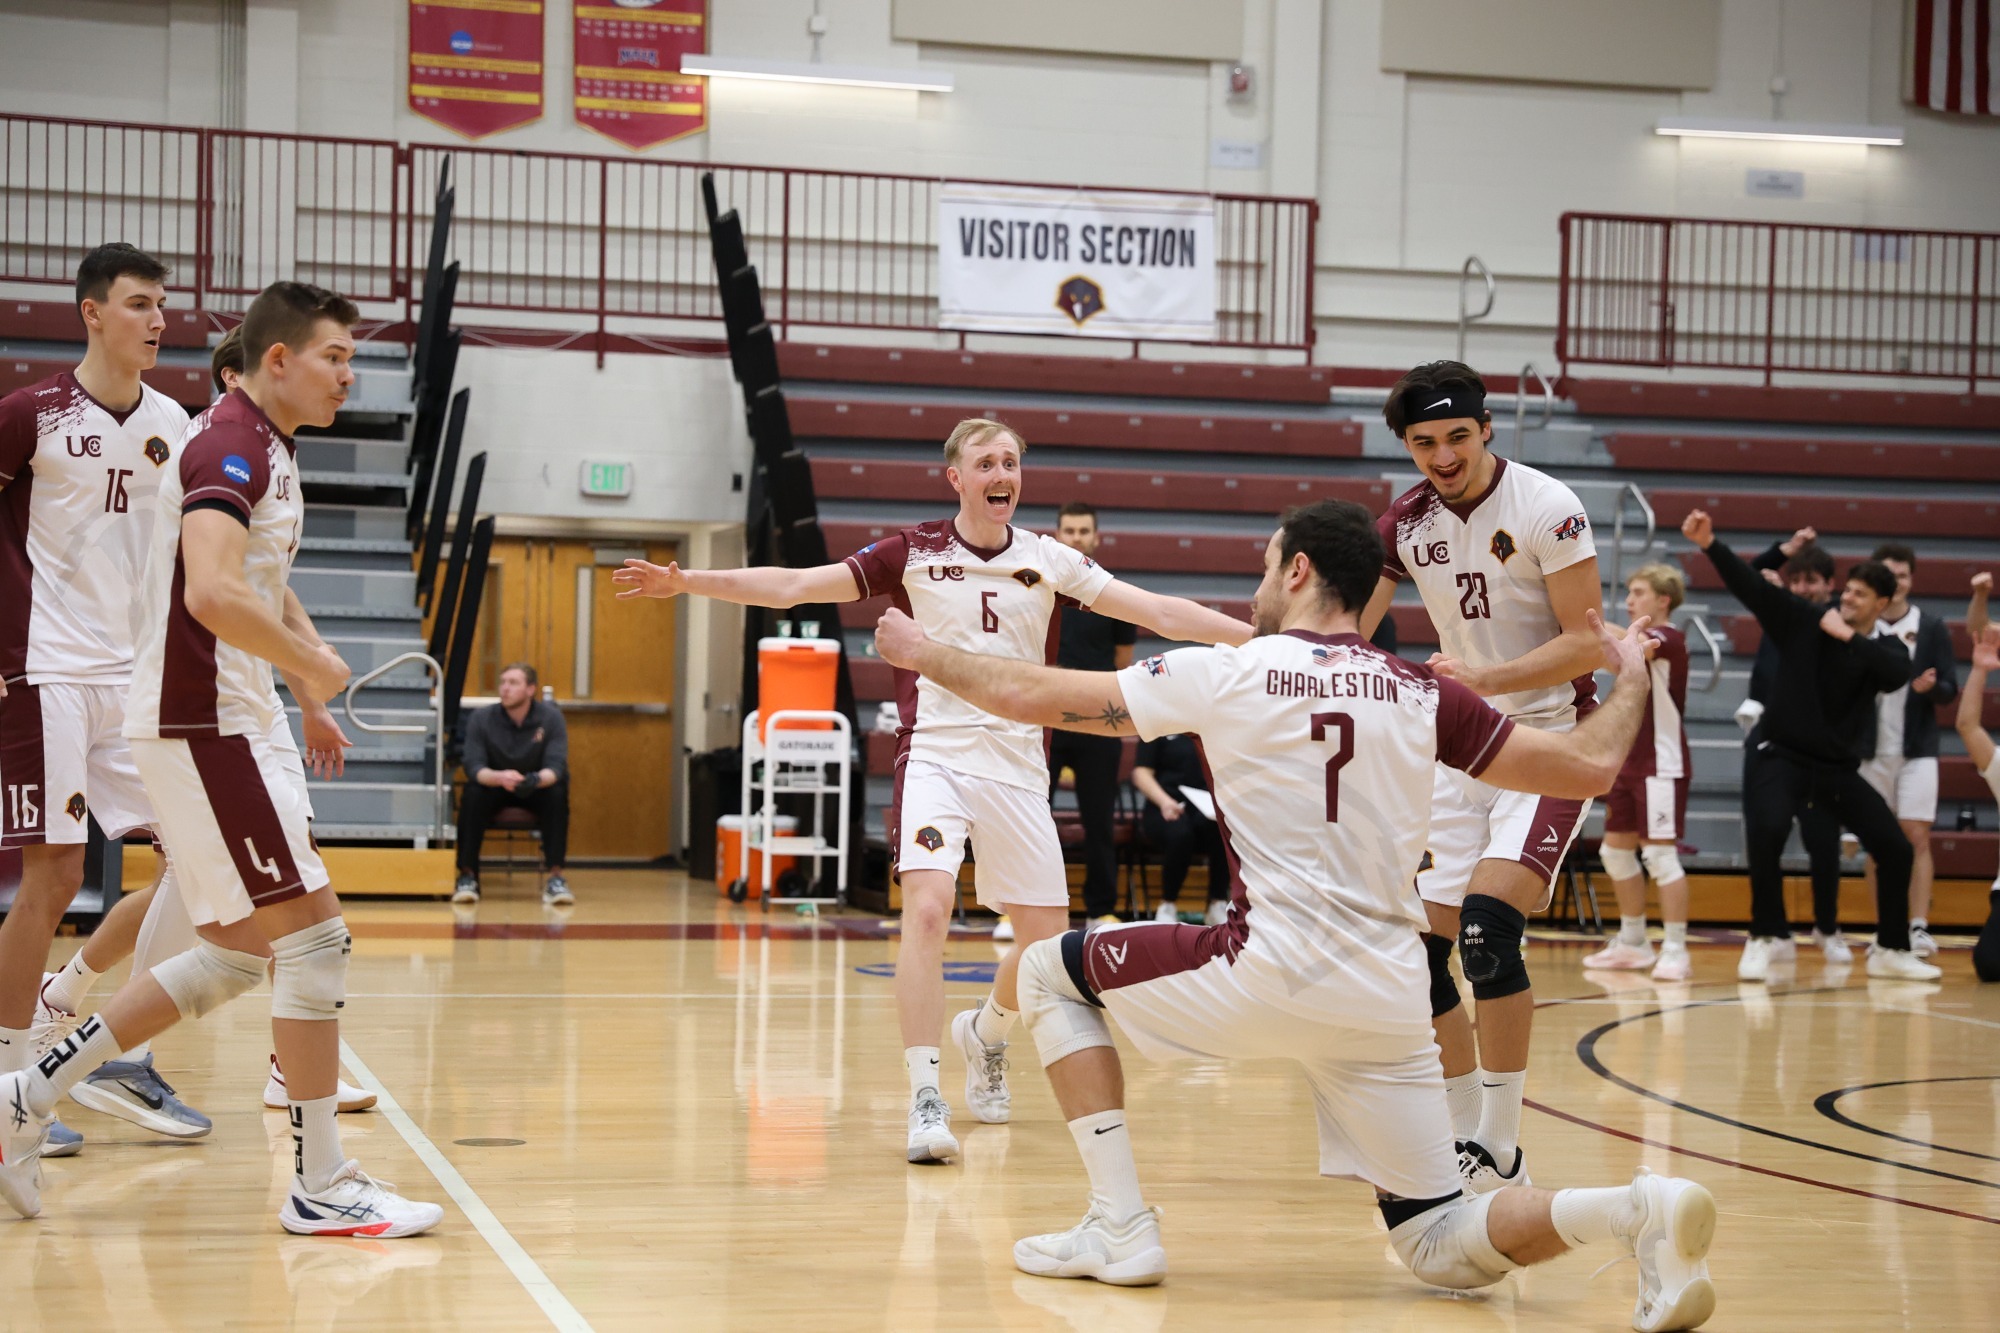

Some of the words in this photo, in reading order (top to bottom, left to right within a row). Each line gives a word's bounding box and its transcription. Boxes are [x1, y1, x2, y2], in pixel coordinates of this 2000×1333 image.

[959, 217, 1070, 262] VISITOR
[1080, 224, 1196, 268] SECTION
[104, 468, 134, 514] 16
[224, 464, 251, 483] NCAA
[590, 463, 625, 492] EXIT
[1561, 523, 1585, 540] EIVA
[981, 590, 999, 634] 6
[1455, 571, 1492, 620] 23
[1266, 668, 1399, 704] CHARLESTON
[778, 740, 835, 750] GATORADE
[1310, 711, 1355, 823] 7
[8, 784, 39, 830] 16
[243, 836, 282, 883] 4
